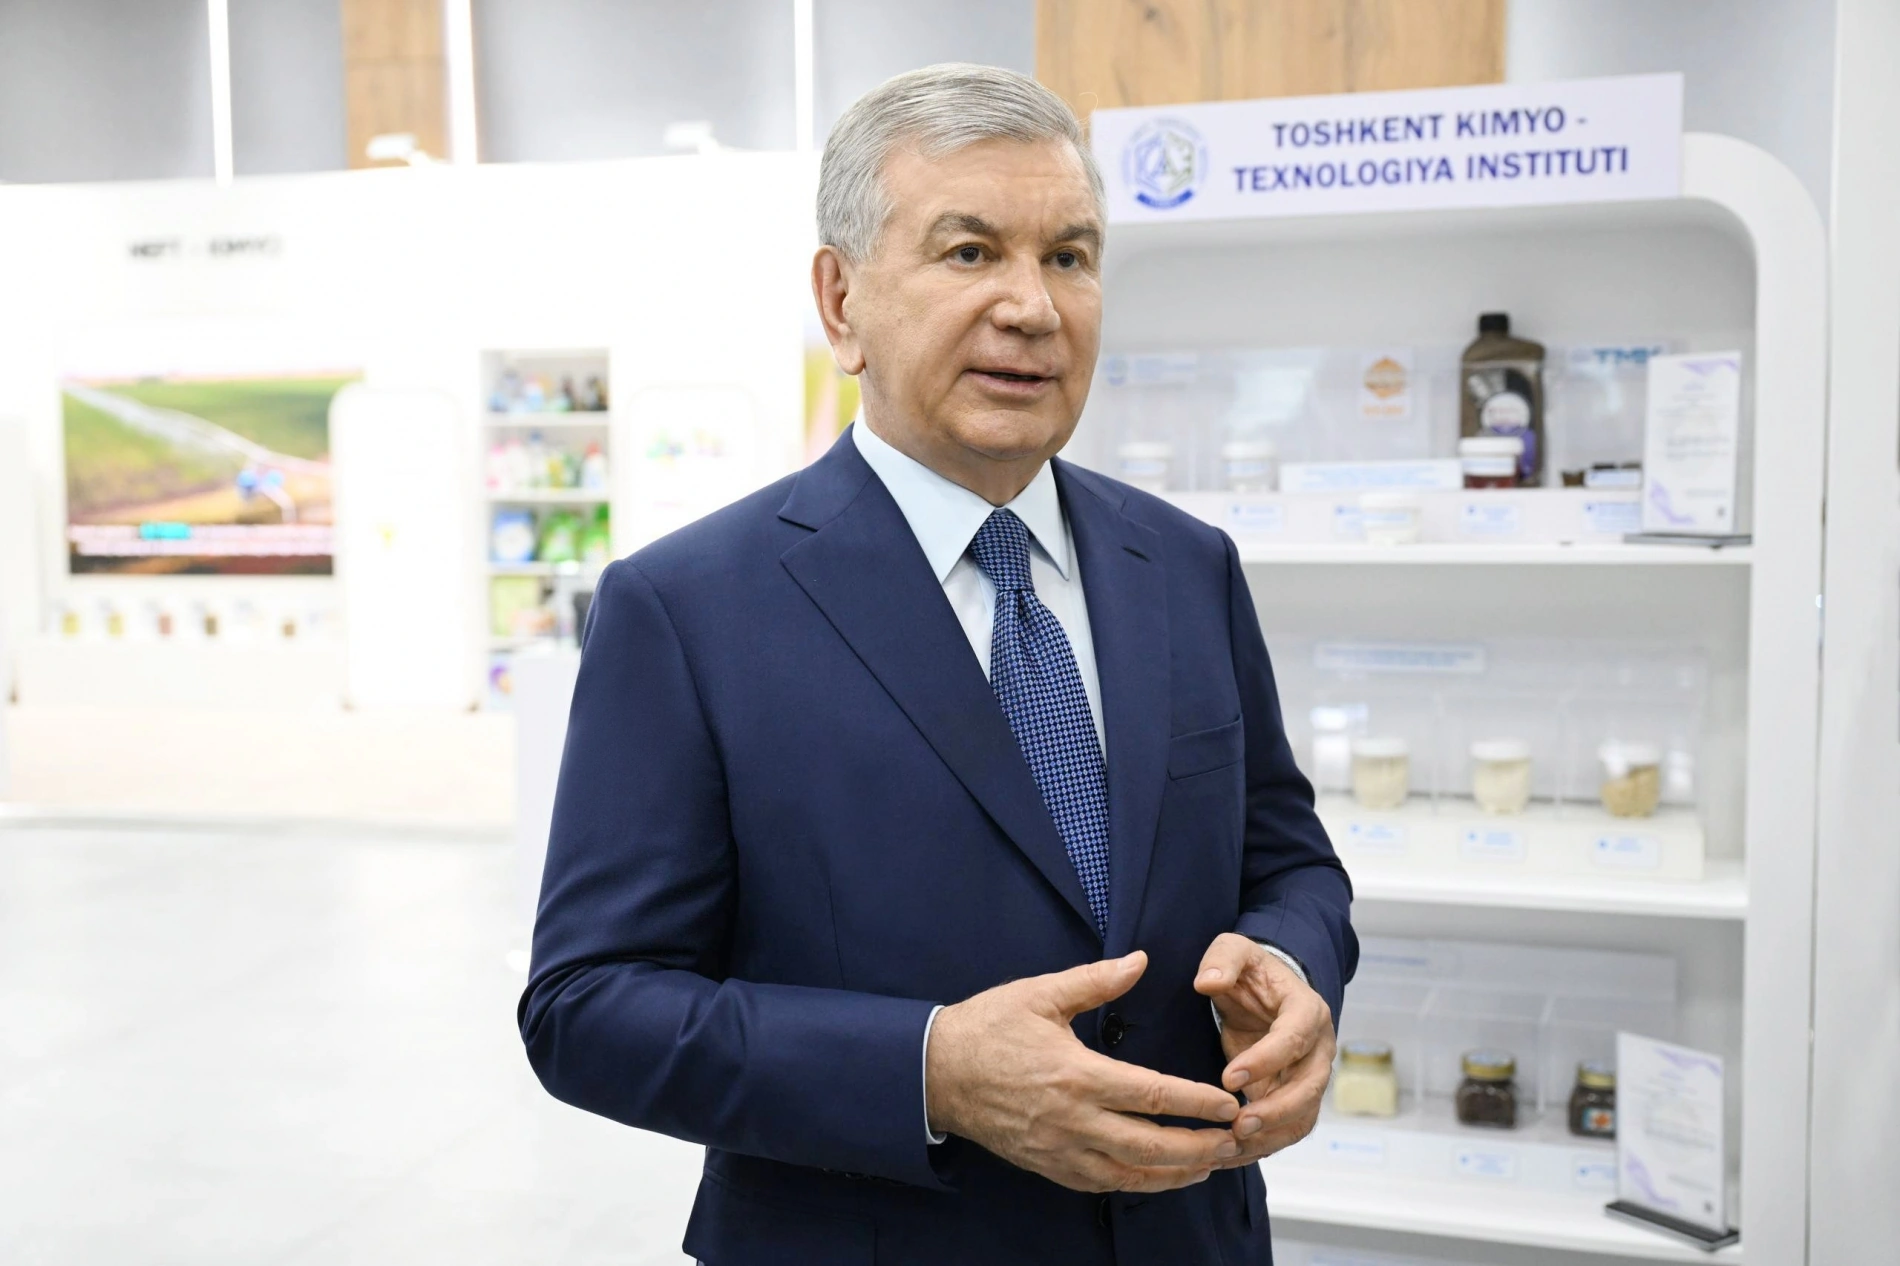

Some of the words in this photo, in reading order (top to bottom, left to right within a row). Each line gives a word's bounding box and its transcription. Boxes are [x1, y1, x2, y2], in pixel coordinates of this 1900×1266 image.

[1272, 112, 1445, 148] TOSHKENT
[1456, 106, 1566, 139] KIMYO
[1233, 154, 1454, 192] TEXNOLOGIYA
[1465, 146, 1629, 180] INSTITUTI
